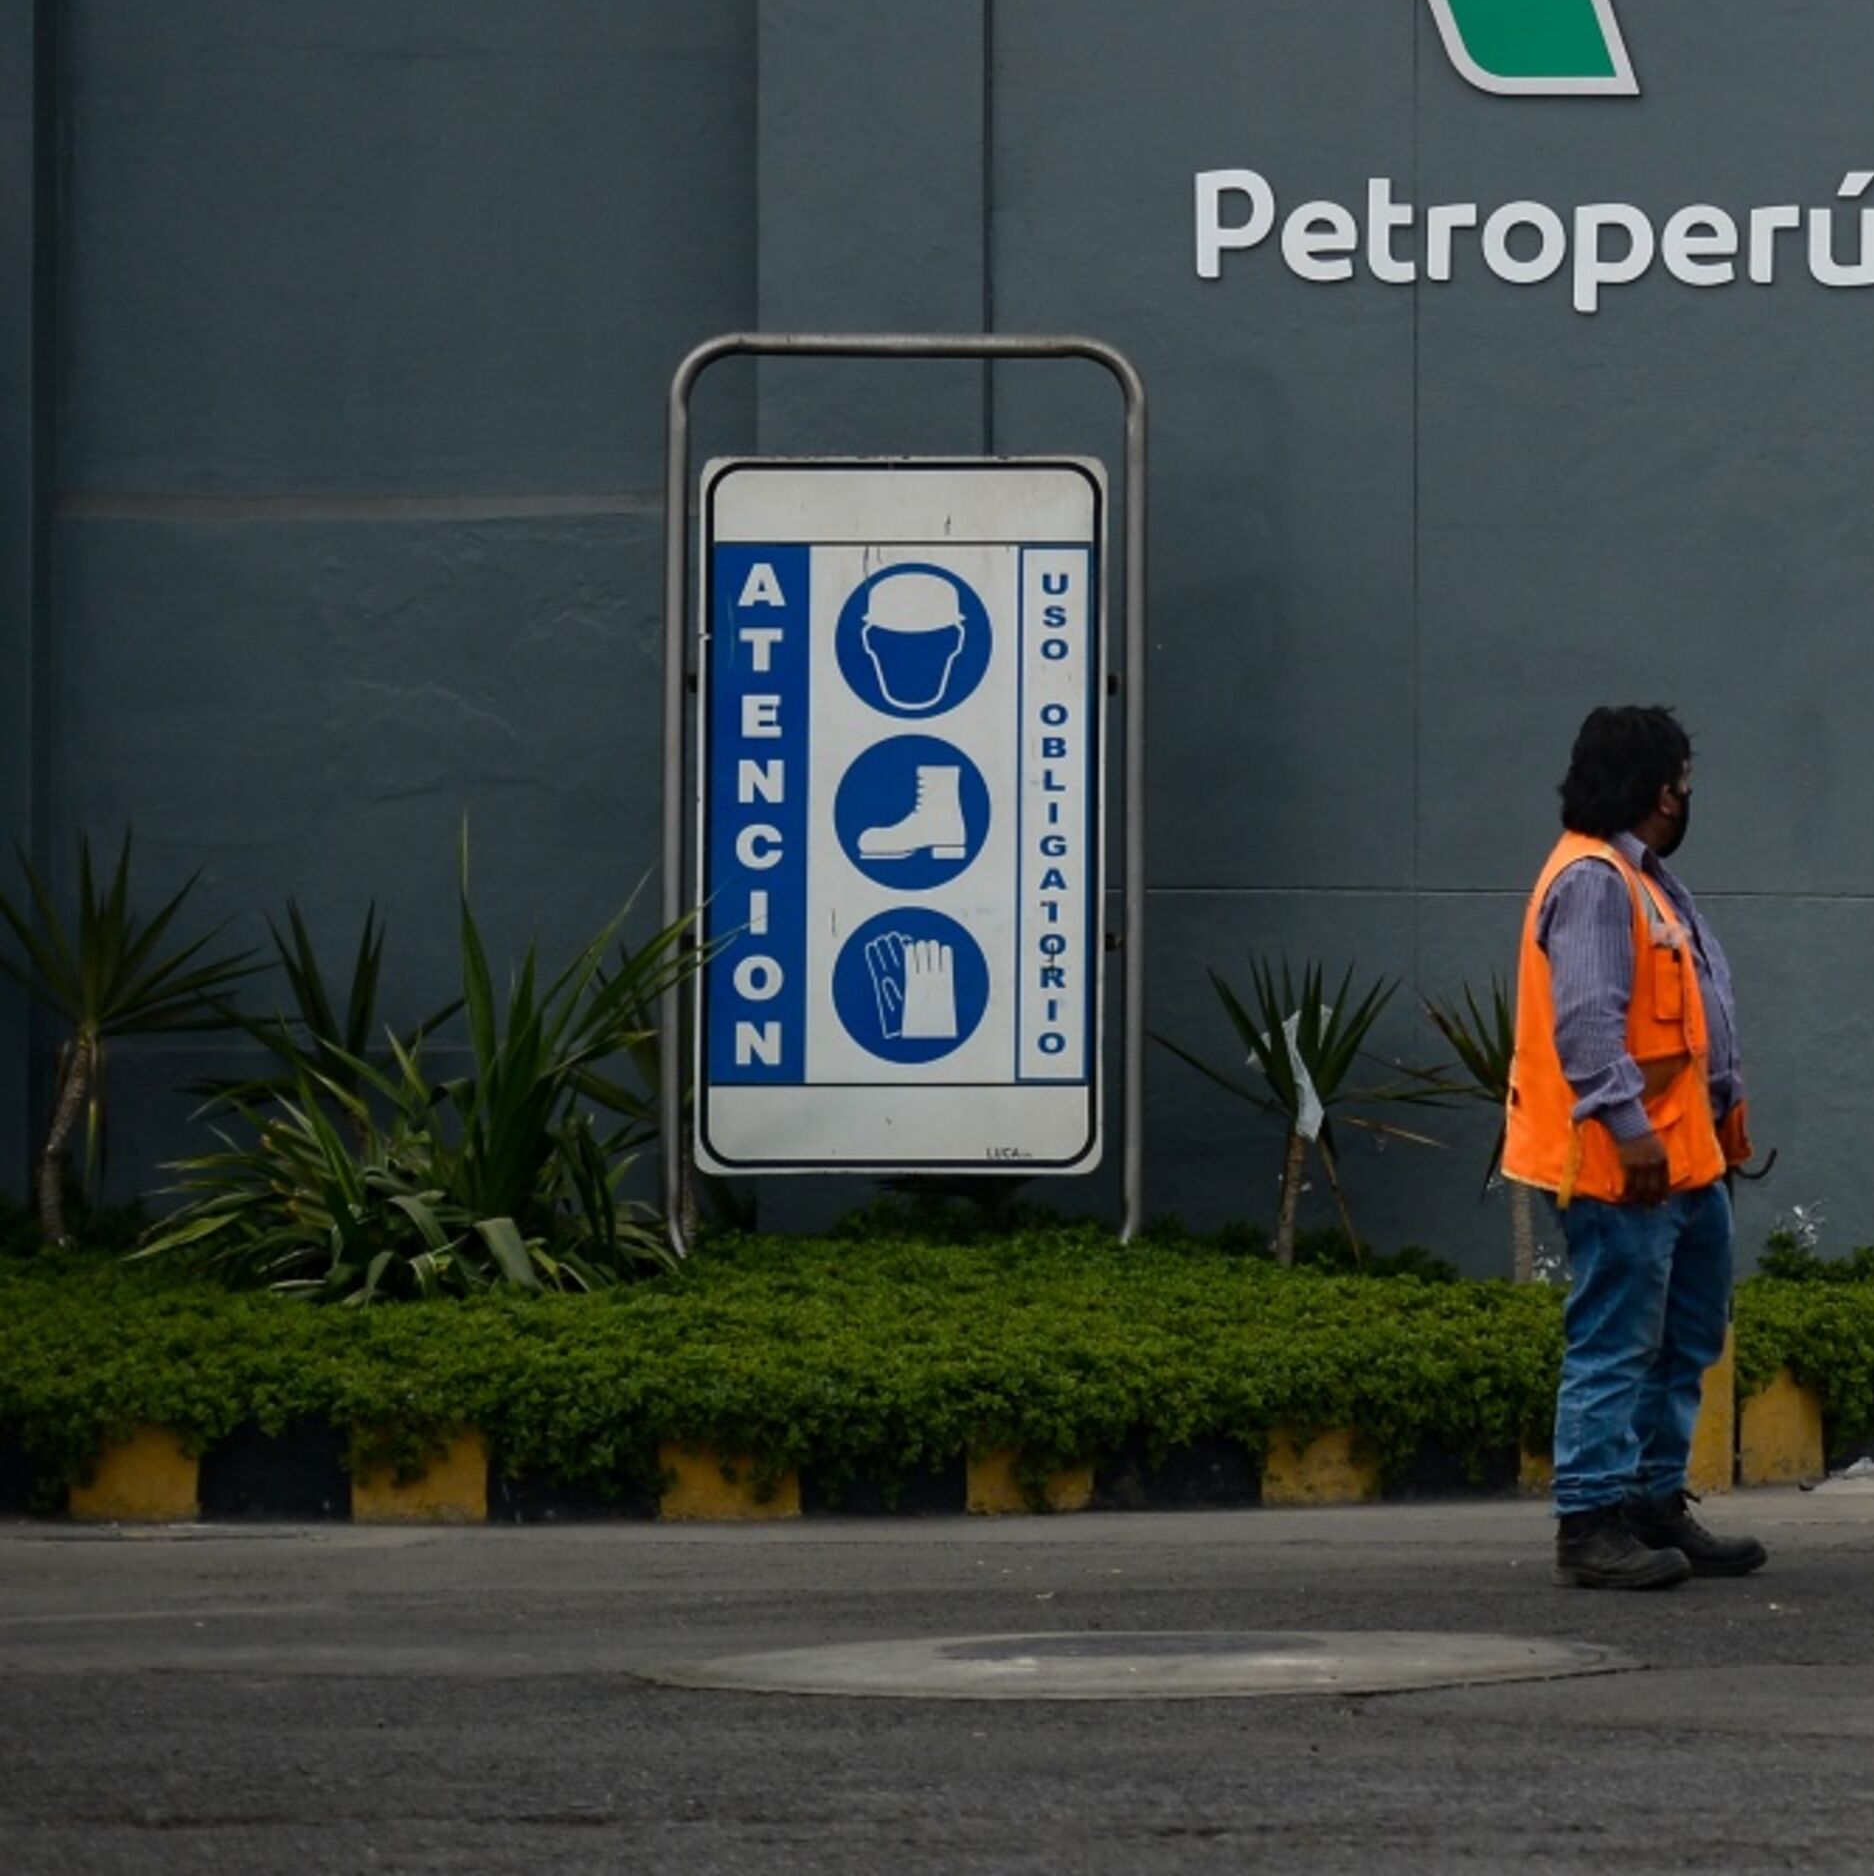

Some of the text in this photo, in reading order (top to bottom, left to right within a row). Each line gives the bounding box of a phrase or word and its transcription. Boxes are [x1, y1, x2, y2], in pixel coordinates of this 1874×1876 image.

[1041, 572, 1070, 661] USO
[735, 562, 787, 1067] ATENCION
[1037, 702, 1069, 1056] OBLIGATORIO
